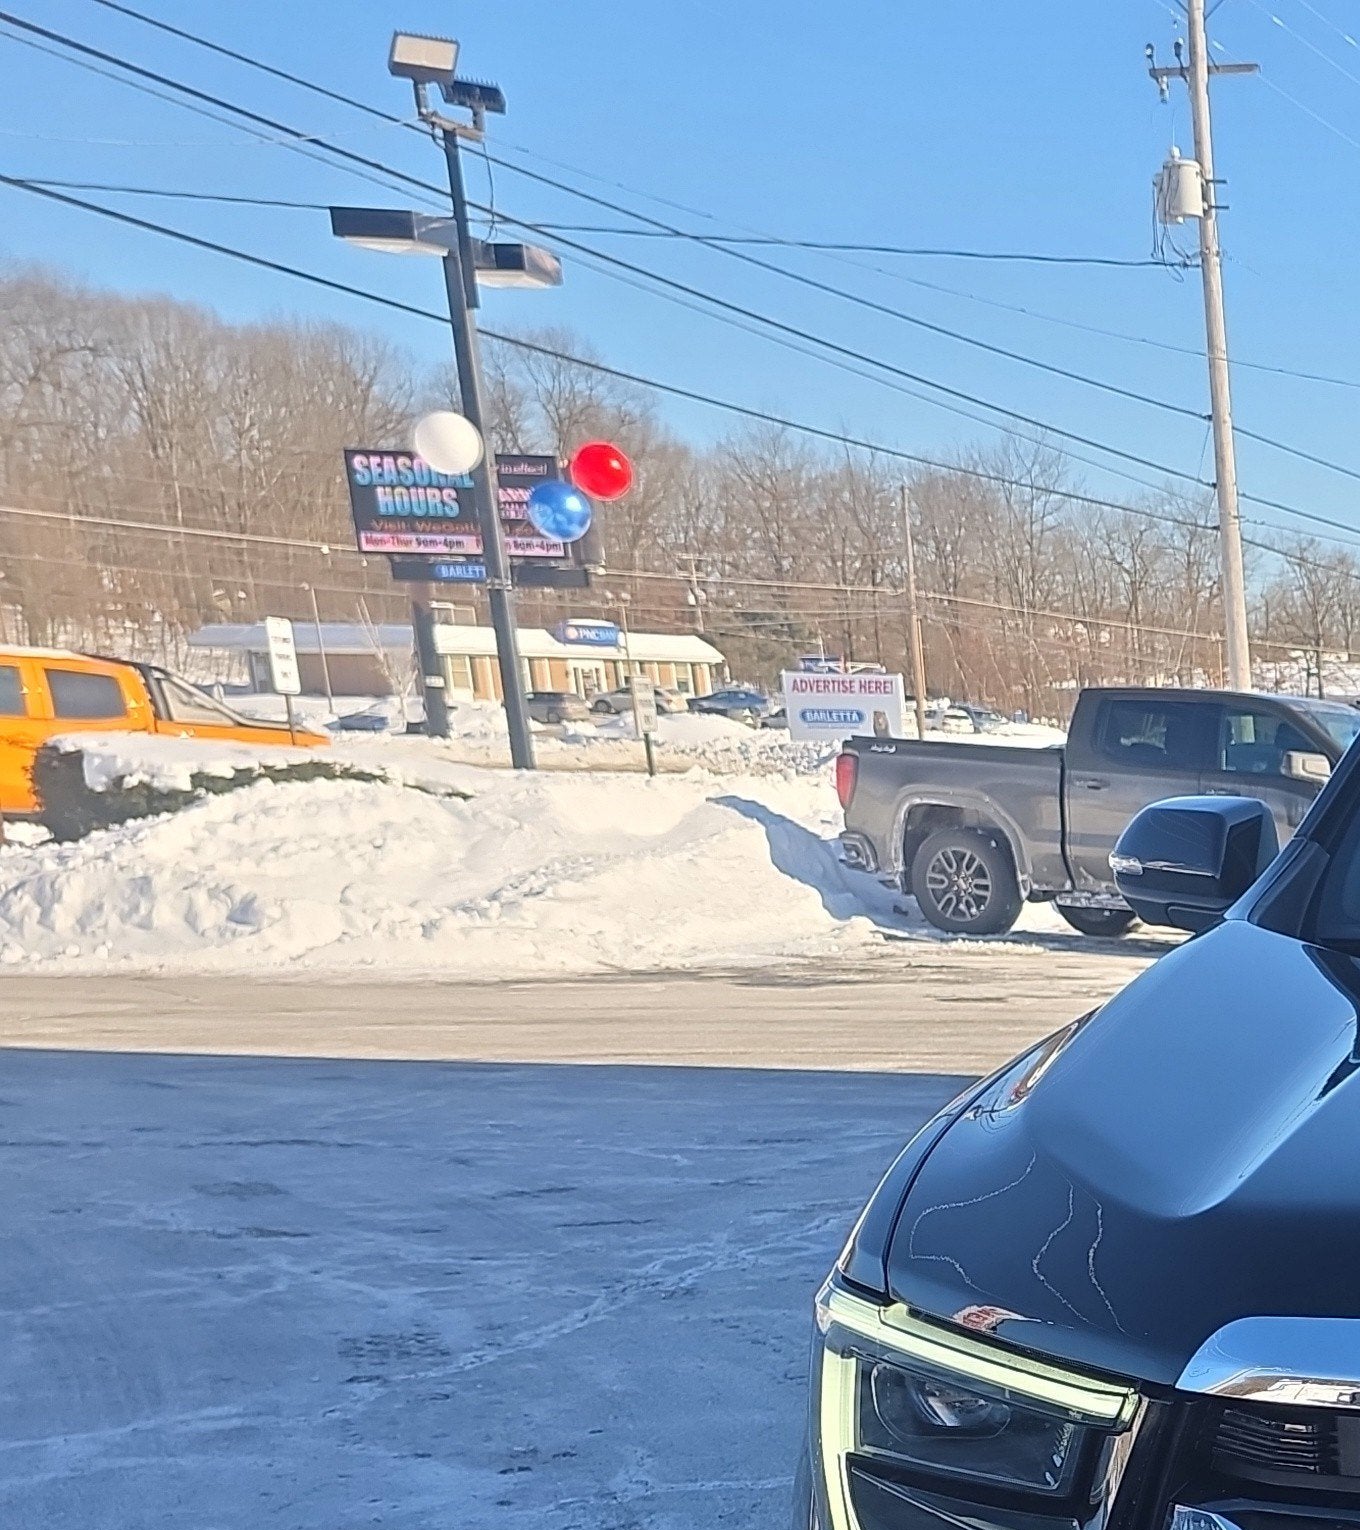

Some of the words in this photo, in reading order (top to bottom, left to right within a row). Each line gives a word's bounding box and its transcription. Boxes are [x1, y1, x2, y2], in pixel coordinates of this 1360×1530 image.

[376, 486, 459, 517] HOURS
[792, 679, 855, 694] ADVERTISE
[860, 681, 894, 695] HERE!
[805, 709, 860, 722] BARLETTA
